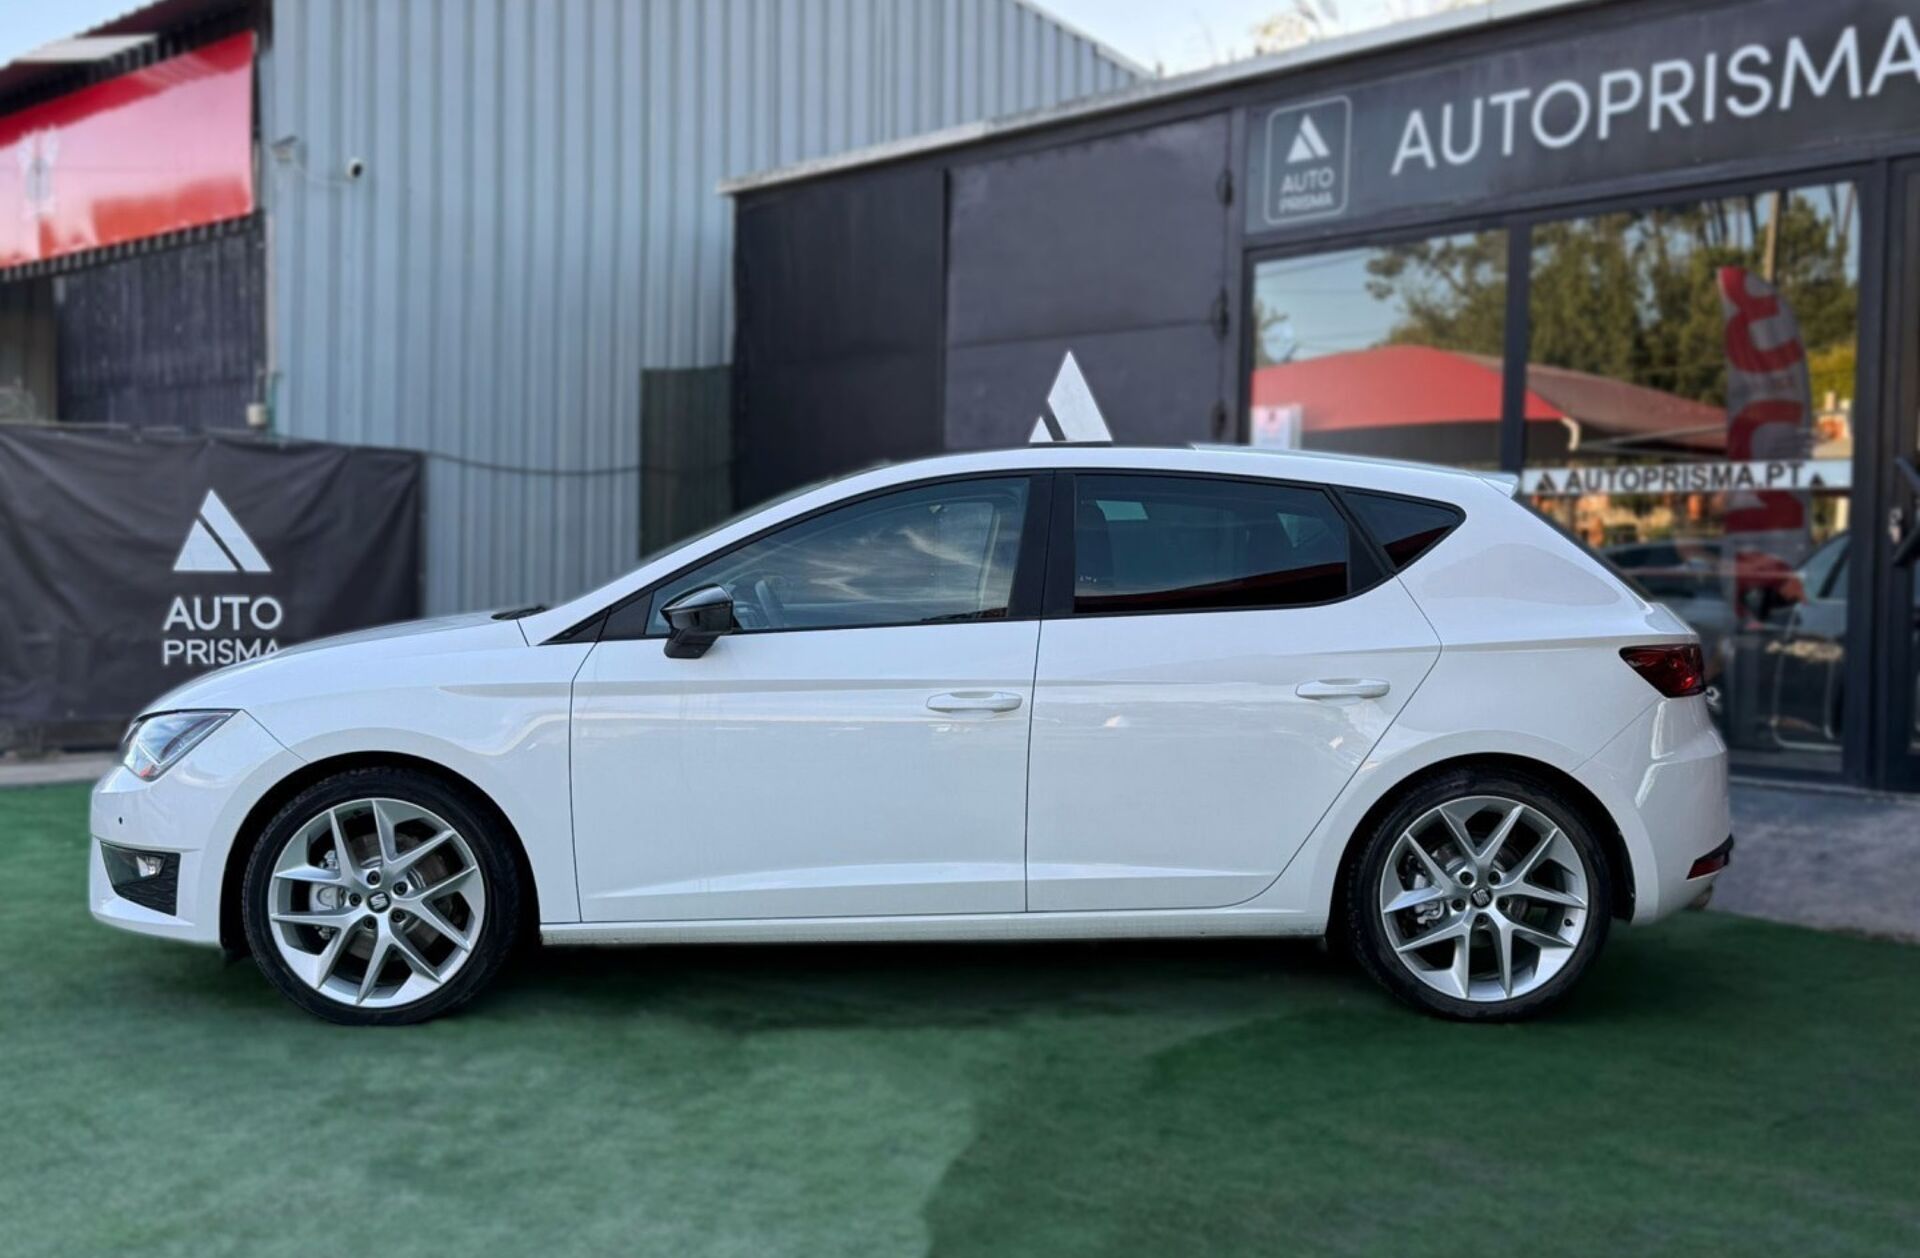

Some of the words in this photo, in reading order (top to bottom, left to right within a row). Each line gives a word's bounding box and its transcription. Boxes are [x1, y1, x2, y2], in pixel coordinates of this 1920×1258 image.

[1391, 15, 1920, 176] AUTOPRISMA
[1281, 166, 1334, 192] AUTO
[1567, 463, 1803, 492] AUTOPRISMA.PT
[163, 596, 282, 631] AUTO
